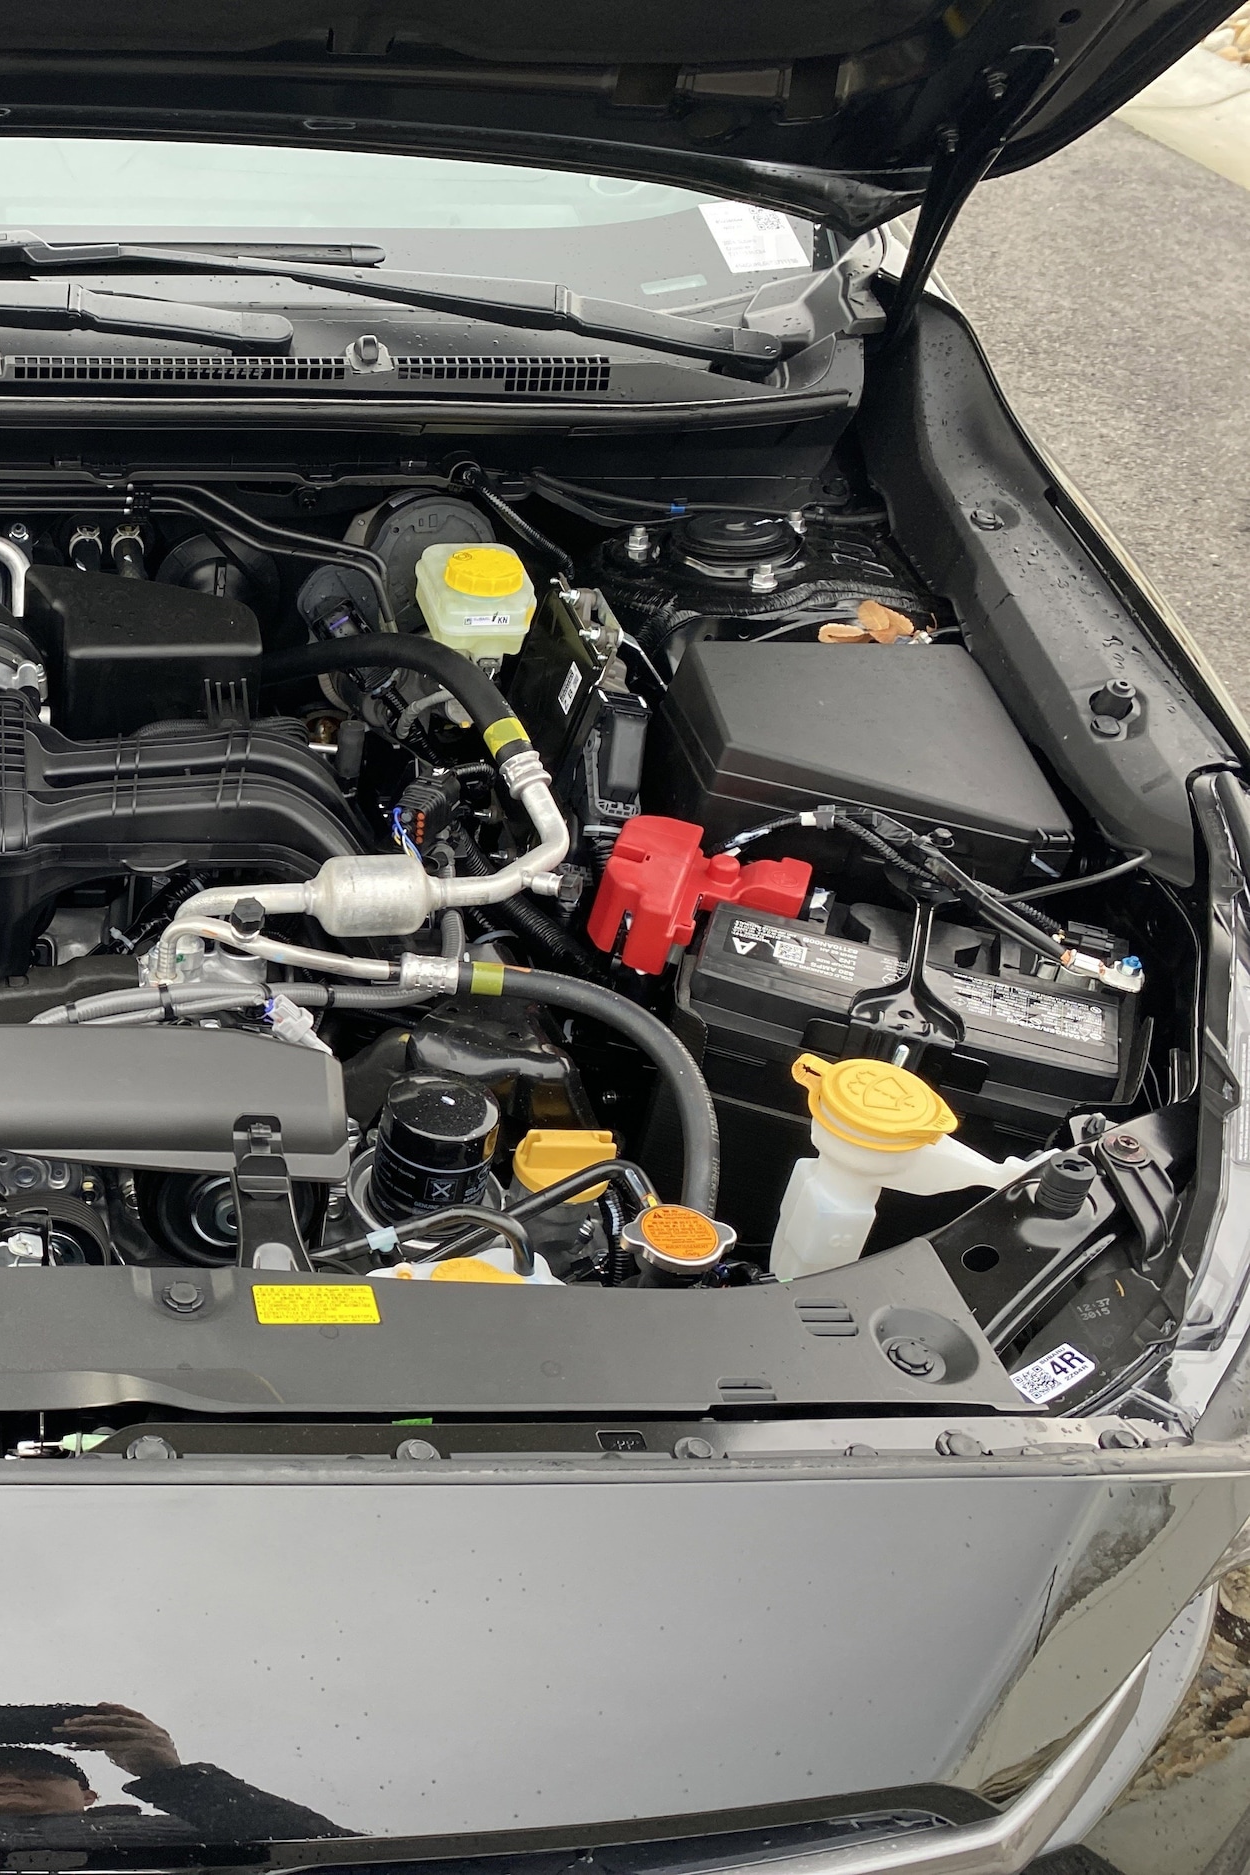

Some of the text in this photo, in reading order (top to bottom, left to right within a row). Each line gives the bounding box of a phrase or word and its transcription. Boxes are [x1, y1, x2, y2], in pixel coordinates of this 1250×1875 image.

[732, 937, 757, 955] A
[779, 959, 798, 968] AMPS
[810, 961, 837, 973] AMPS
[835, 973, 854, 982] COLD
[1039, 1347, 1066, 1365] SUBARU
[1050, 1350, 1086, 1376] 4R
